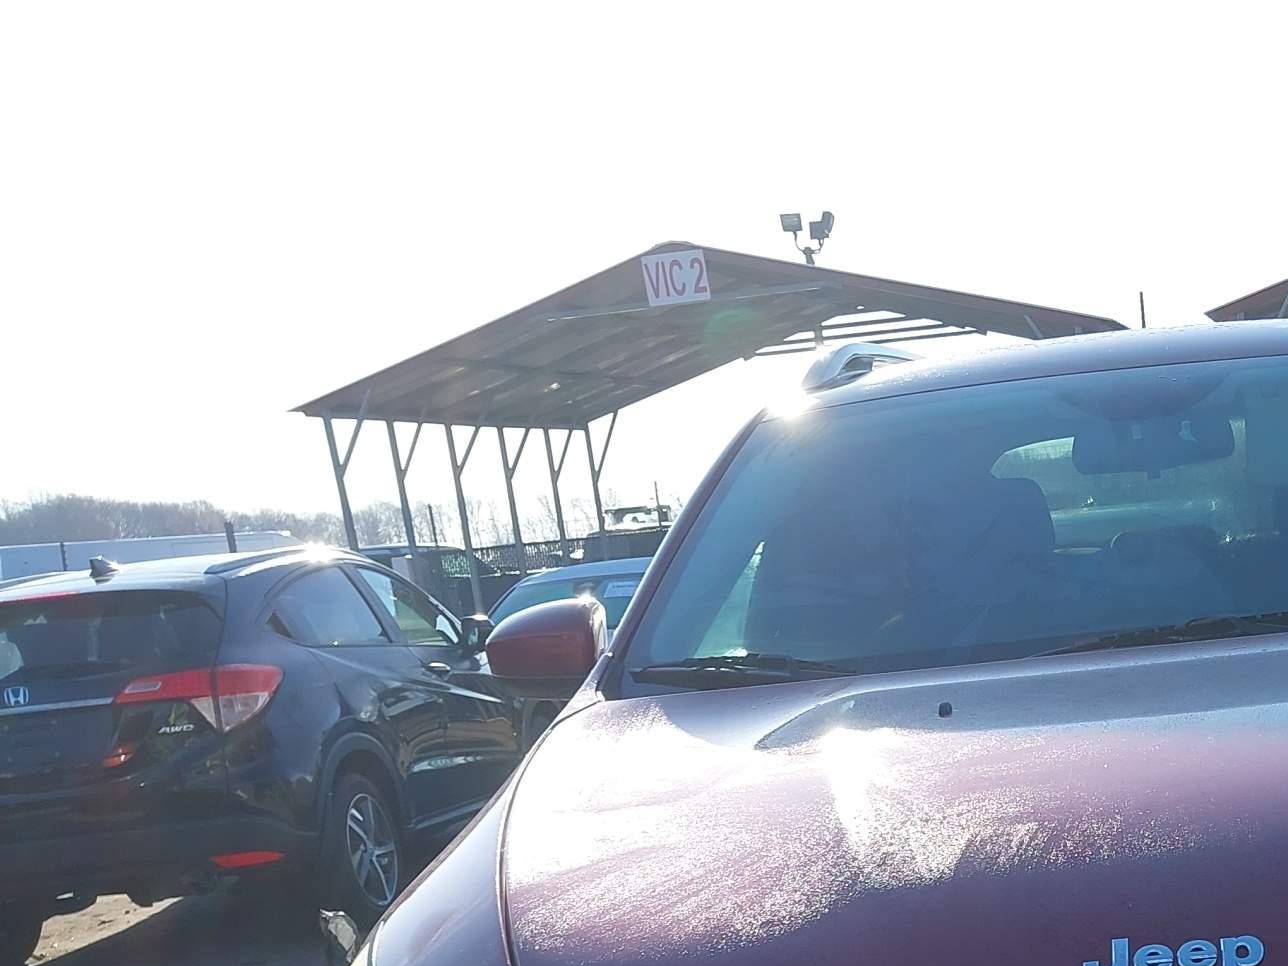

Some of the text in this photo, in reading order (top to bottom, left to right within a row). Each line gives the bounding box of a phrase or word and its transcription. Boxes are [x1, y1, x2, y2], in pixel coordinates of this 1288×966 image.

[643, 257, 708, 299] VIC 2
[158, 723, 194, 734] AWD
